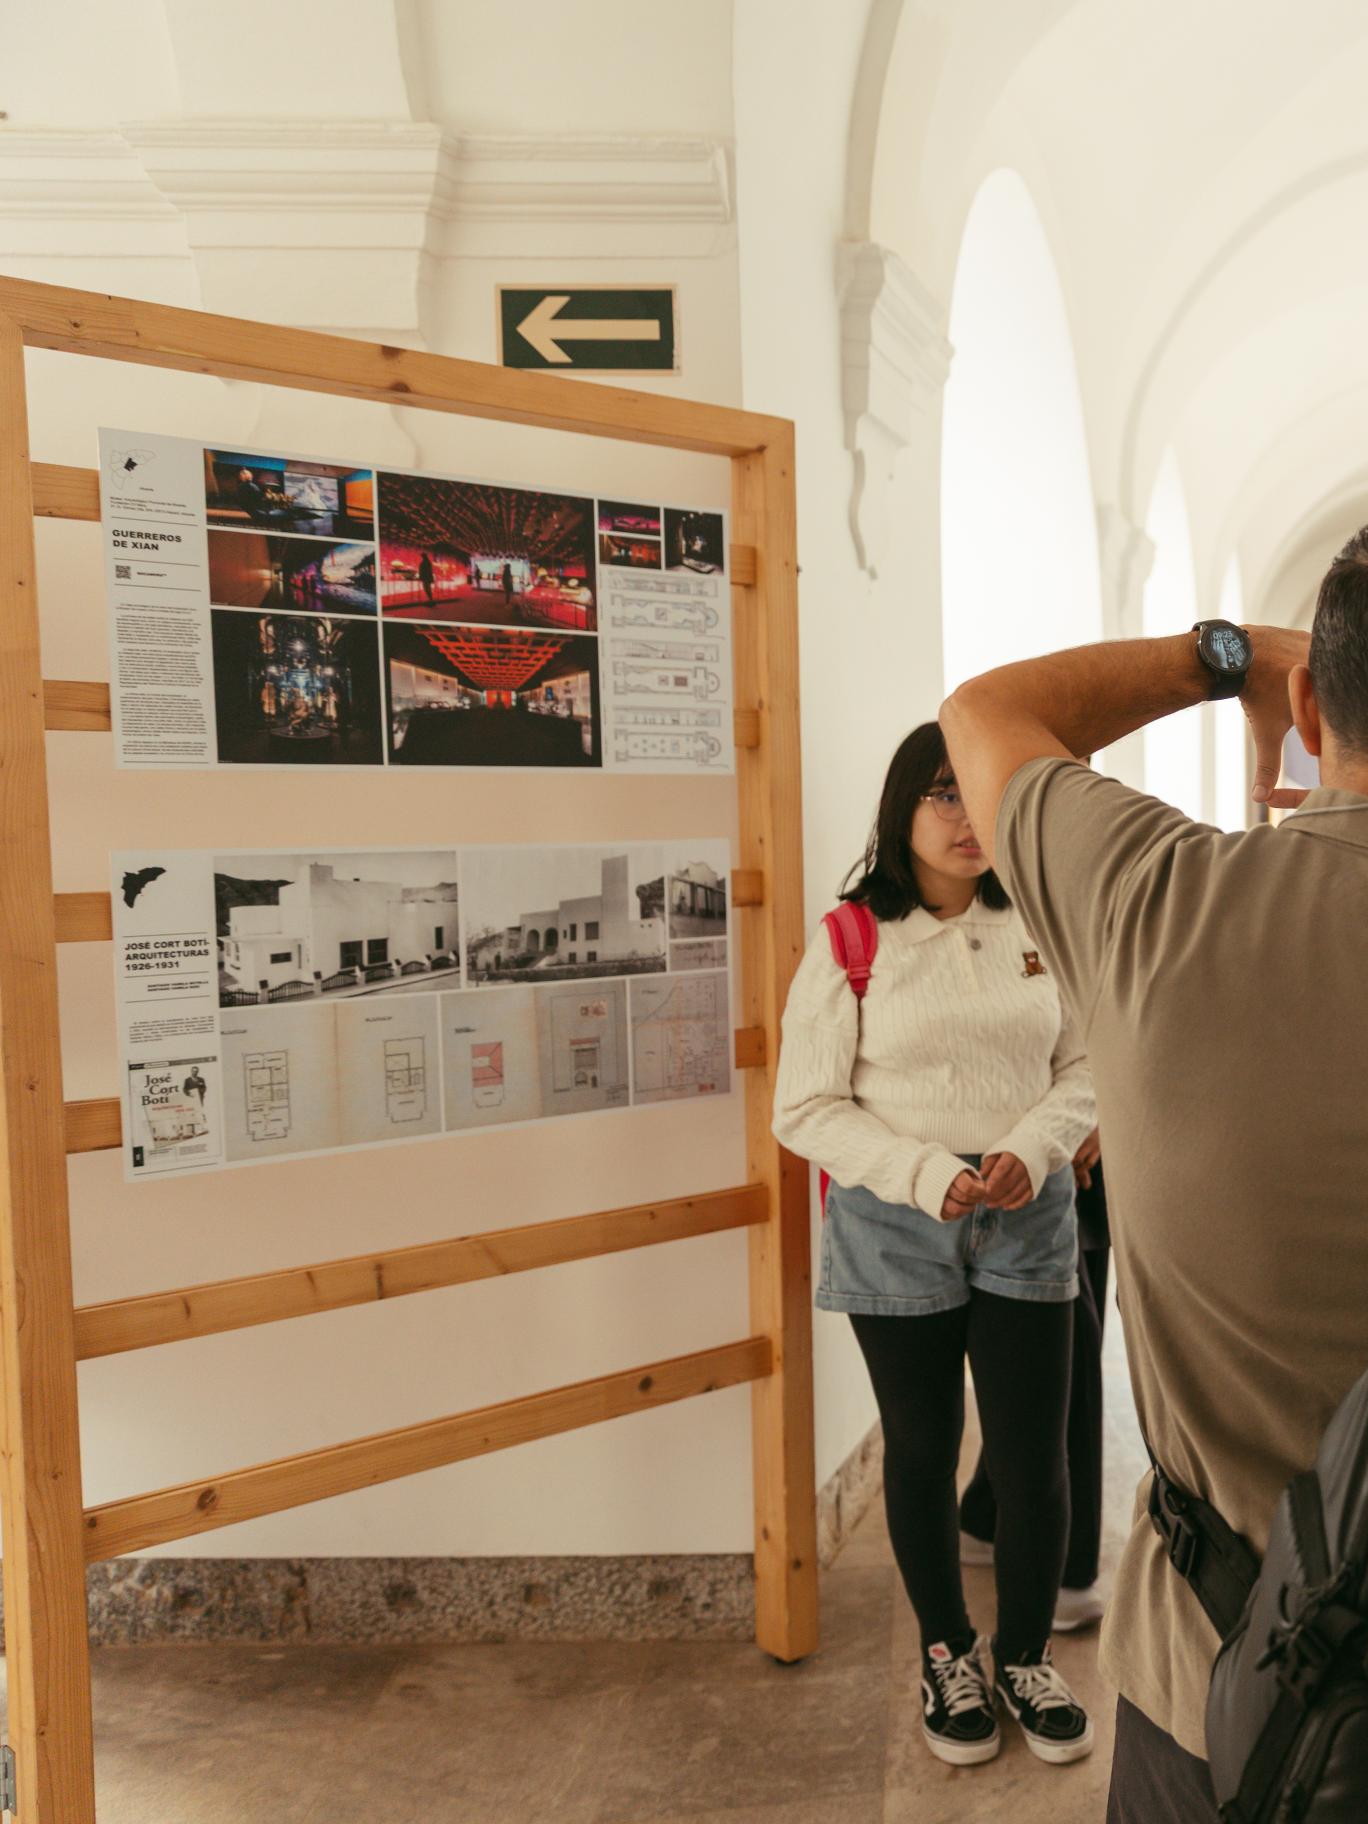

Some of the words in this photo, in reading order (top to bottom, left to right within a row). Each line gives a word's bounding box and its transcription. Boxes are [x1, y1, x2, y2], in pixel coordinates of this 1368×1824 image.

[112, 529, 182, 543] GUERREROS
[112, 540, 128, 549] DE
[132, 541, 159, 551] XIAN
[124, 939, 151, 951] JOSÉ
[153, 940, 180, 949] CORT
[125, 949, 210, 961] ARQUITECTURAS
[125, 961, 180, 971] 1926-1931
[144, 1072, 173, 1088] José
[149, 1083, 180, 1095] Cort
